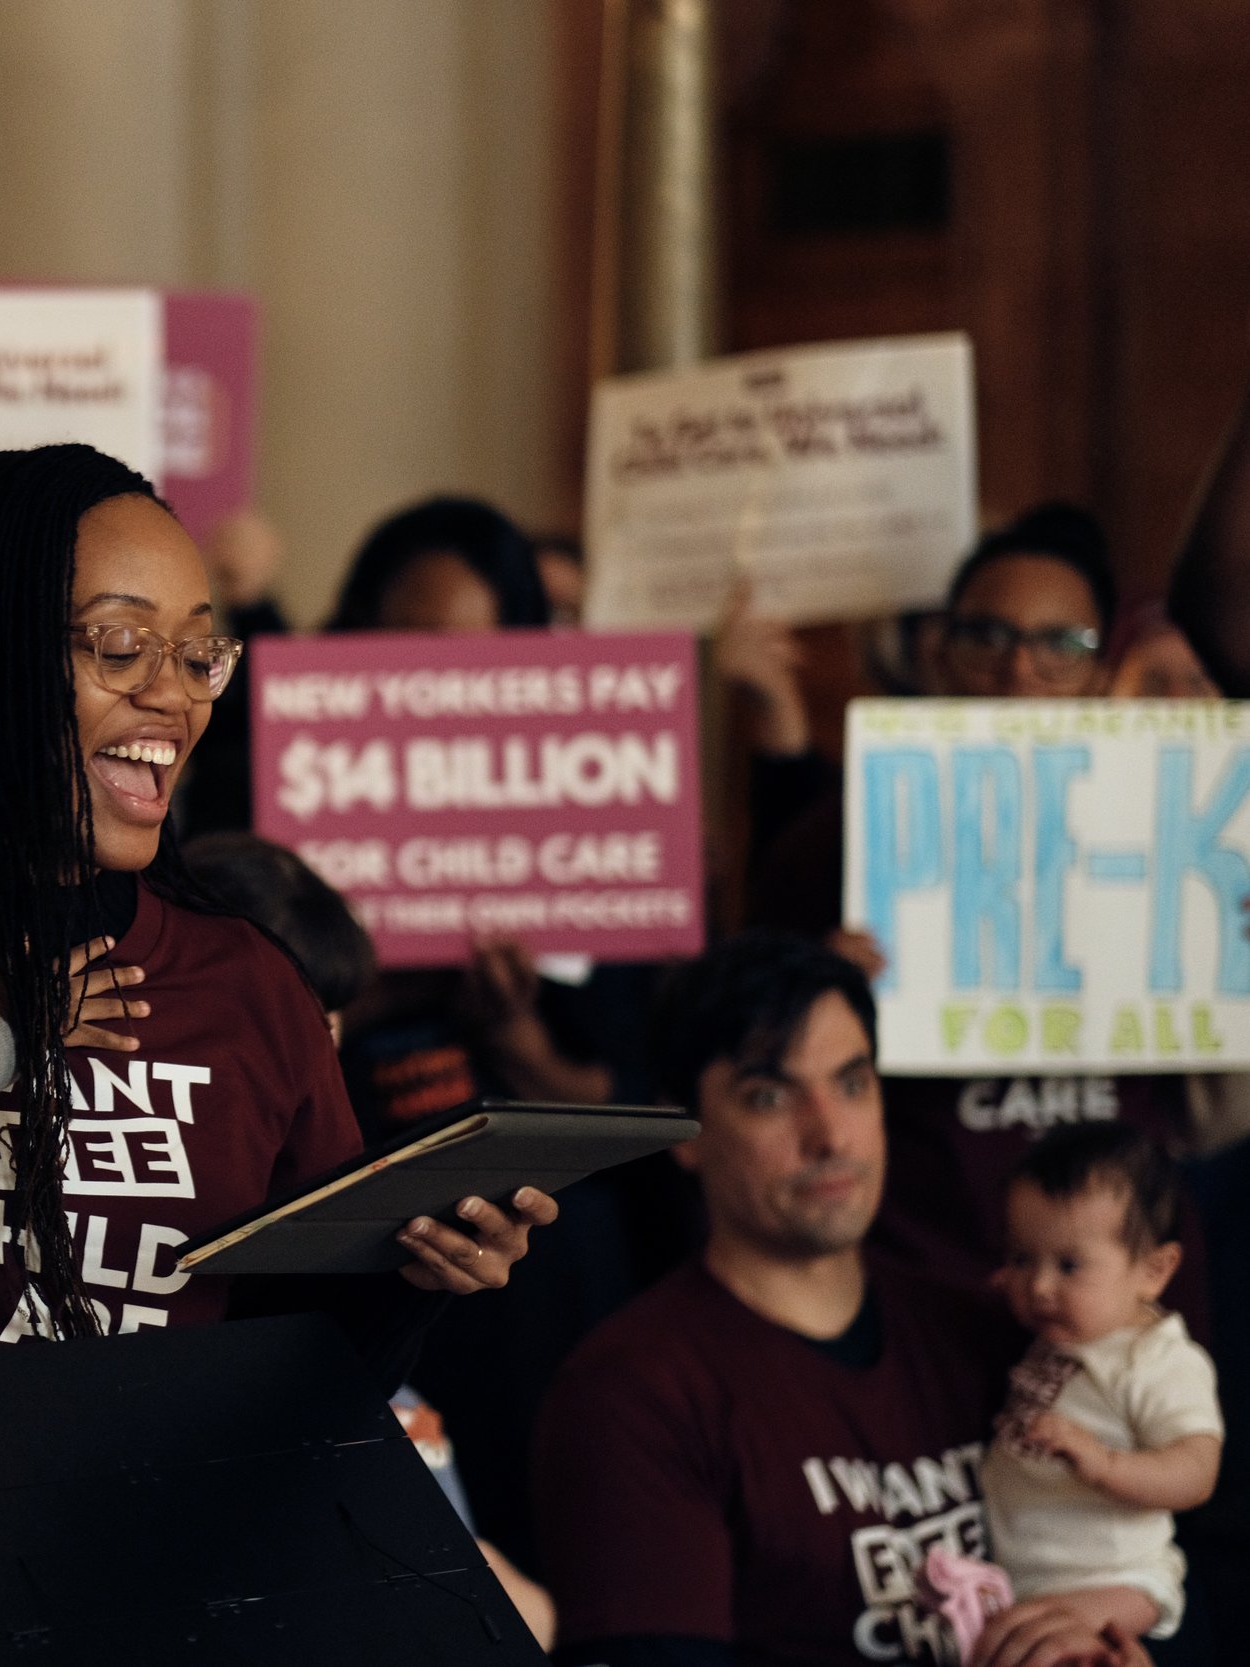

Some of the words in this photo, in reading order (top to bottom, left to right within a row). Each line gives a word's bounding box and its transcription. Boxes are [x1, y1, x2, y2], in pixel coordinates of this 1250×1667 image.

[262, 673, 369, 721] NEW
[374, 664, 582, 718] YORKERS
[588, 662, 682, 713] PAY
[277, 732, 397, 822] $14
[404, 729, 678, 810] BILLION
[395, 835, 535, 888] CHILD
[537, 831, 662, 884] CARE
[862, 746, 1250, 992] PRE-K
[940, 1004, 1083, 1056] FOR
[1109, 1003, 1224, 1055] ALL
[801, 1455, 839, 1516] I
